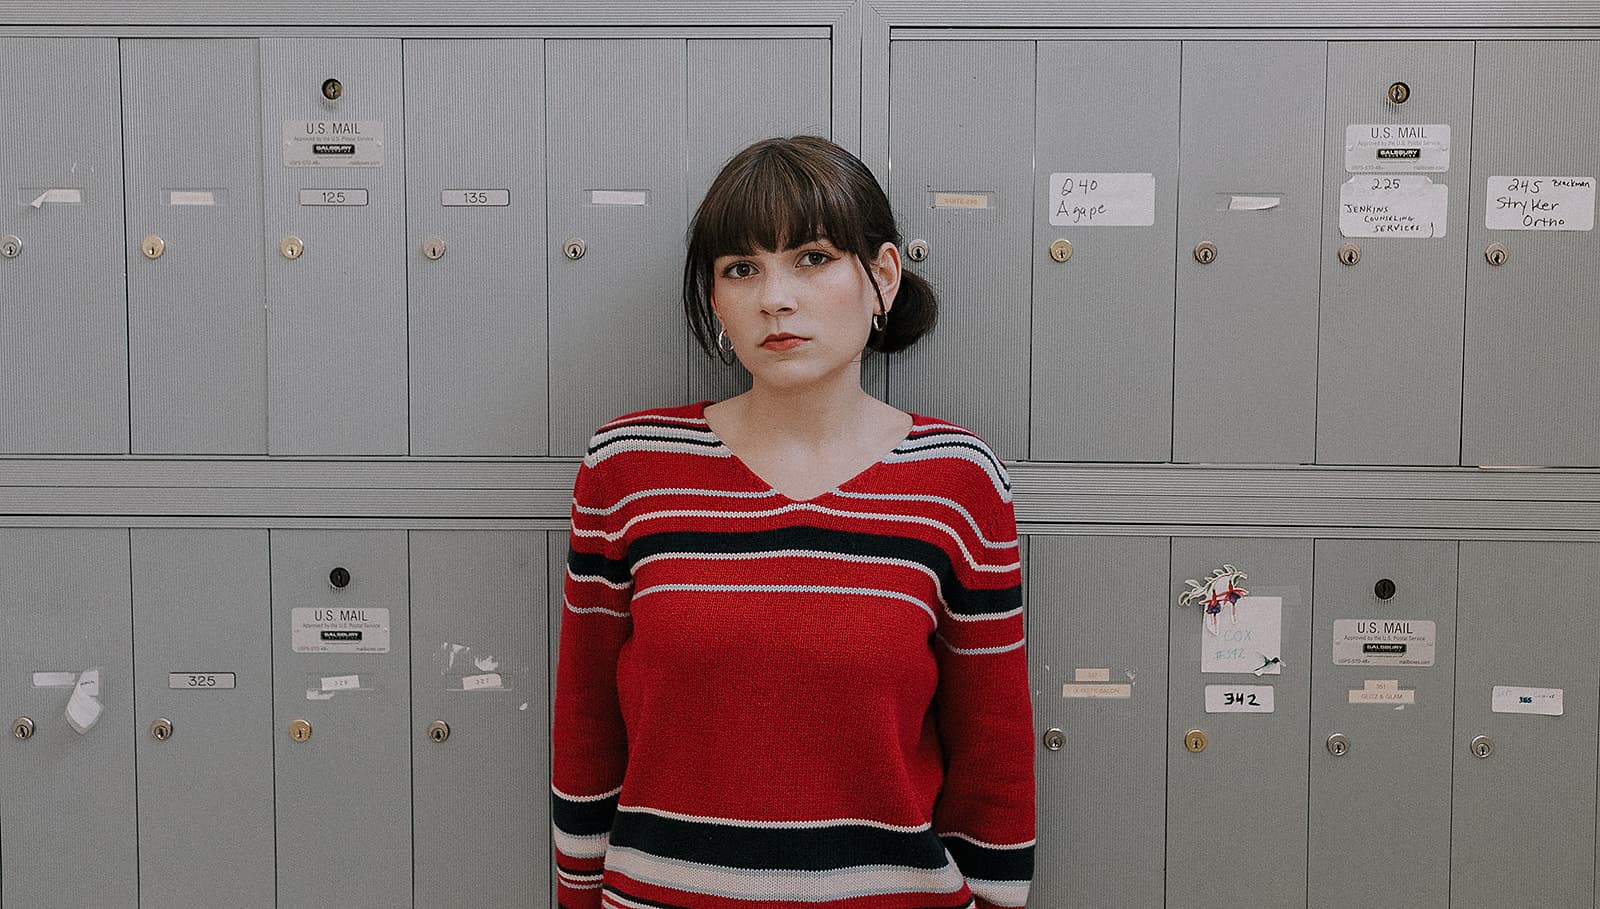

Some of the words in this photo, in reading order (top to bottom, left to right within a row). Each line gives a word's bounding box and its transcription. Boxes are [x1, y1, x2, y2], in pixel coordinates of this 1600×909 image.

[306, 122, 328, 134] U.S.
[332, 122, 360, 134] MAIL
[1370, 126, 1394, 138] U.S.
[1398, 126, 1427, 138] MAIL
[1371, 178, 1401, 190] 225
[1507, 178, 1543, 193] 245
[322, 191, 346, 203] 125
[464, 192, 488, 203] 135
[1056, 200, 1107, 223] Agape
[1344, 203, 1389, 214] JENKINS
[1364, 215, 1415, 223] COUNSELING
[1522, 214, 1565, 227] Ortho
[314, 609, 337, 621] U.S.
[340, 610, 368, 622] MAIL
[1357, 621, 1380, 634] U.S.
[1384, 622, 1413, 634] MAIL
[1224, 629, 1253, 640] COX
[188, 675, 216, 687] 325
[1223, 692, 1261, 706] 342
